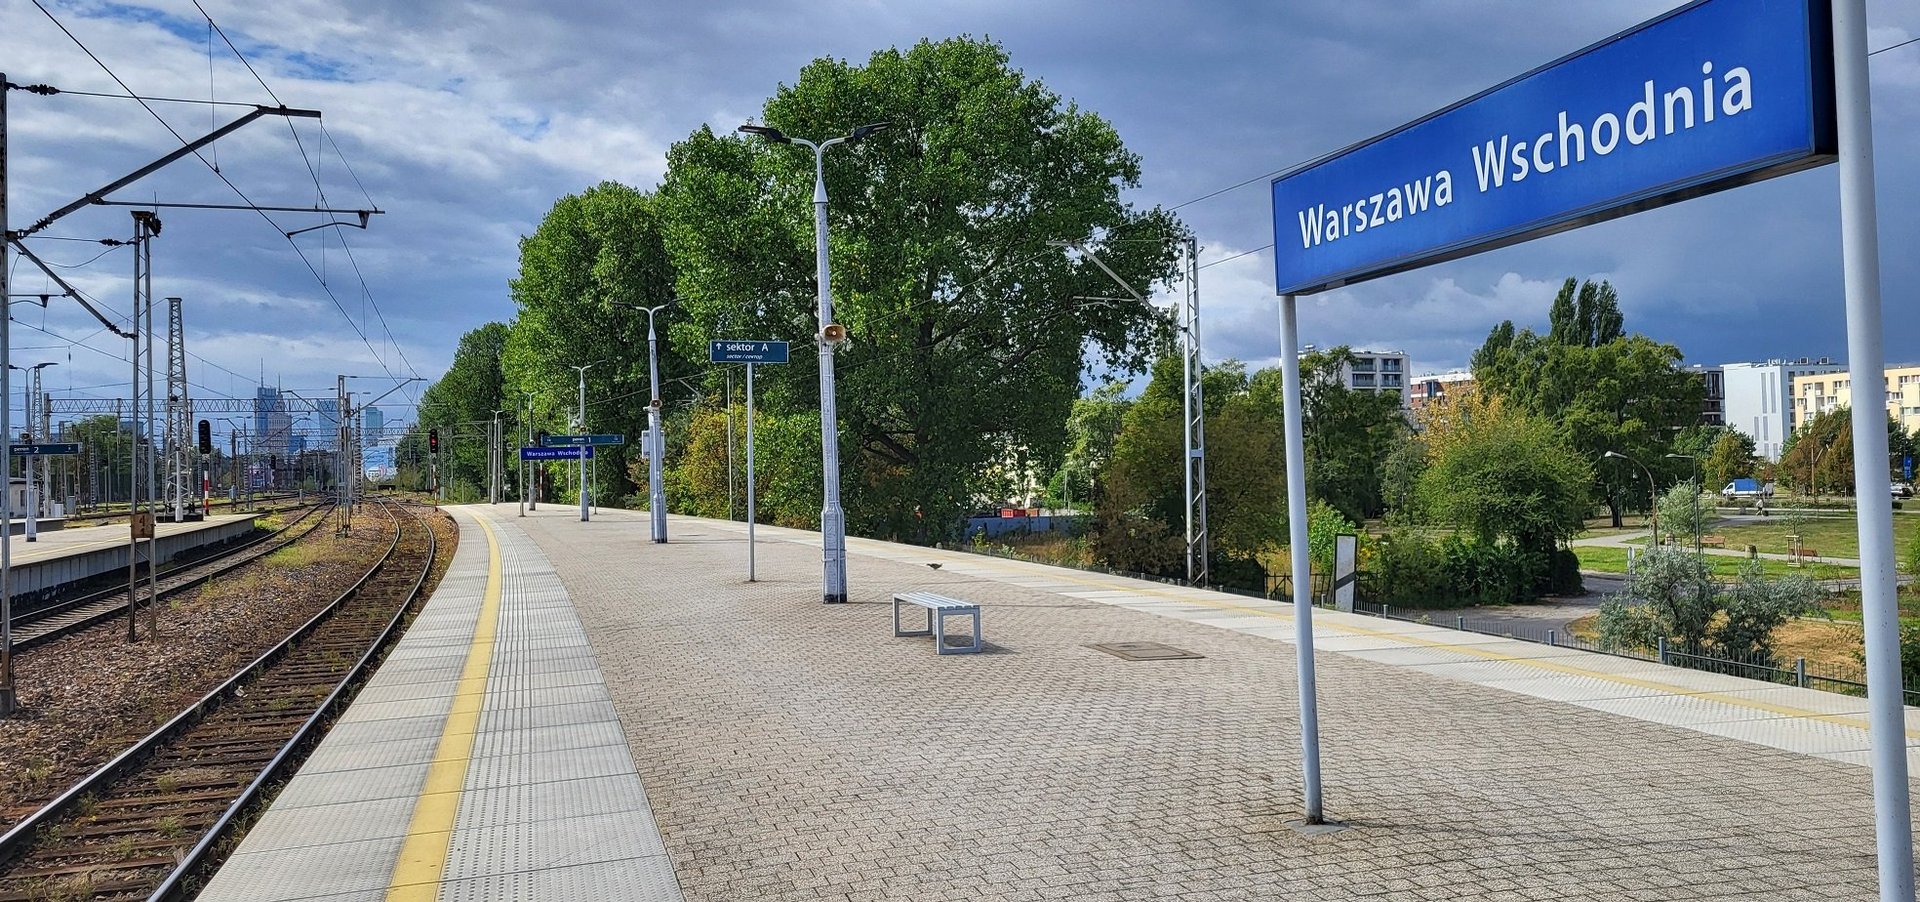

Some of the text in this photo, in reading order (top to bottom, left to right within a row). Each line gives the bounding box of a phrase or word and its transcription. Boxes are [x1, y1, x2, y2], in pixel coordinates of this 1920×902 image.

[1298, 60, 1753, 248] Warszawa Wschodnia
[726, 343, 769, 352] sektor A
[33, 446, 39, 454] 2
